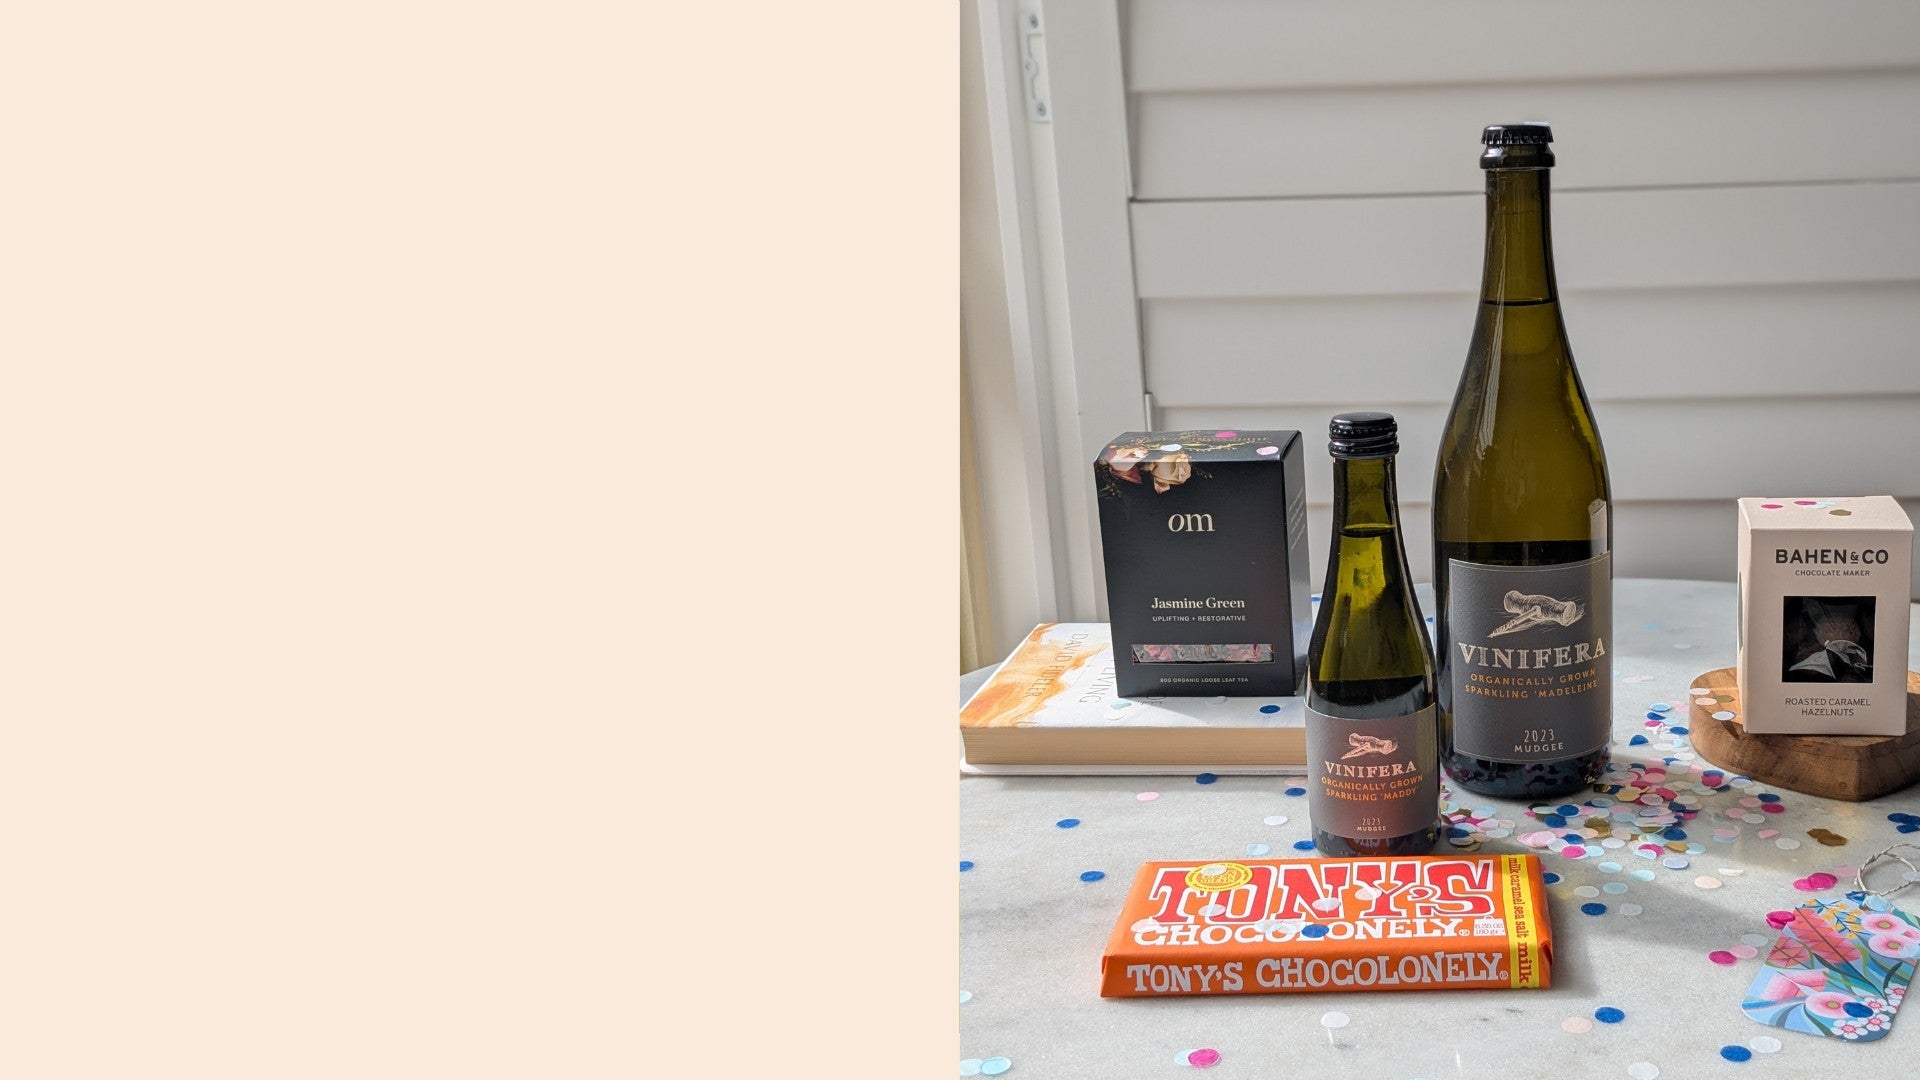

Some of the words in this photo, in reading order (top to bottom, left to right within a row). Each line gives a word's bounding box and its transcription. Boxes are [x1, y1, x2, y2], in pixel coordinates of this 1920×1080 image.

[1168, 513, 1216, 532] om
[1151, 597, 1203, 609] Jasmine
[1206, 597, 1246, 609] Green
[1054, 633, 1089, 663] DAVID
[1458, 638, 1606, 669] VINIFERA
[1470, 673, 1554, 686] ORGANICALLY
[1559, 668, 1596, 684] GROWN
[1464, 684, 1528, 698] SPARKLING
[1785, 698, 1827, 706] ROASTED
[1828, 698, 1871, 706] CARAMEL
[1801, 708, 1855, 716] HAZELNUTS
[1524, 729, 1555, 743] 2023
[1514, 743, 1564, 753] MUDGEE
[1324, 760, 1417, 778] VINIFERA
[1321, 776, 1386, 791] ORGANICALLY
[1389, 774, 1424, 790] GROWN
[1326, 788, 1377, 801] SPARKLING
[1362, 817, 1381, 826] 2023
[1508, 857, 1521, 874] milk
[1149, 859, 1495, 924] TONY'S
[1510, 873, 1526, 905] caramel
[1514, 905, 1525, 920] sea
[1515, 920, 1530, 939] salt
[1518, 942, 1532, 984] milk
[1127, 962, 1244, 992] TONY'S
